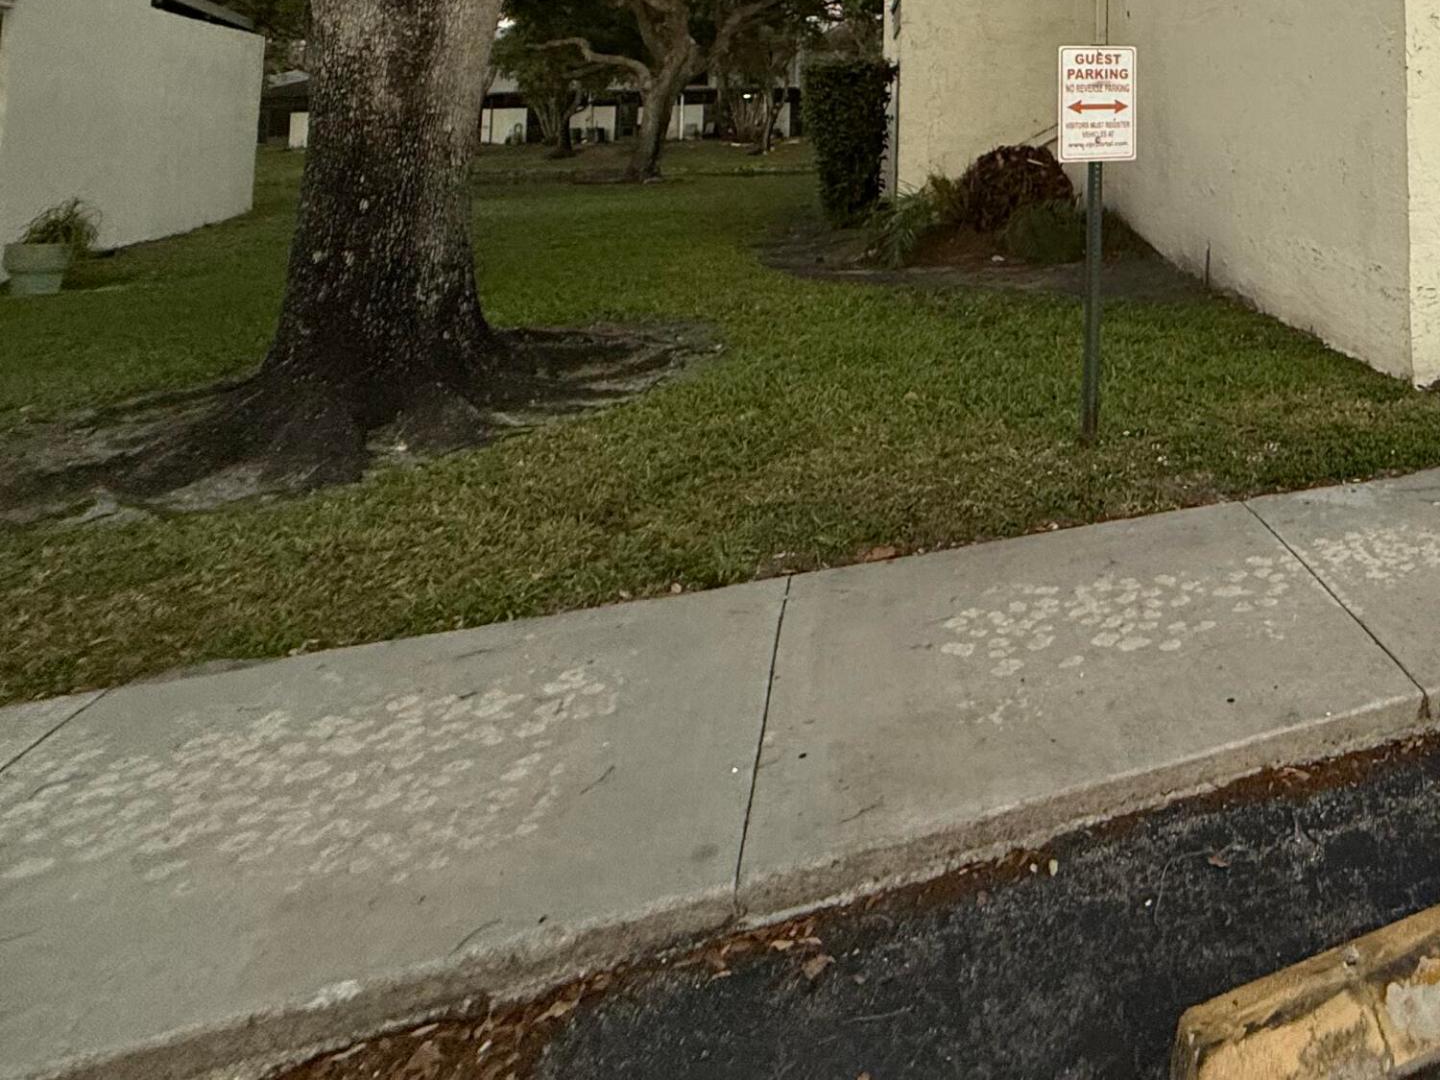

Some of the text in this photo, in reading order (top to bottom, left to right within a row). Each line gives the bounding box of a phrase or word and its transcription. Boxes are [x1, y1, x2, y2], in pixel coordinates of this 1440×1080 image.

[1075, 54, 1121, 65] GUEST
[1067, 68, 1129, 80] PARKING
[1066, 83, 1130, 93] NO REVERSE PARKING
